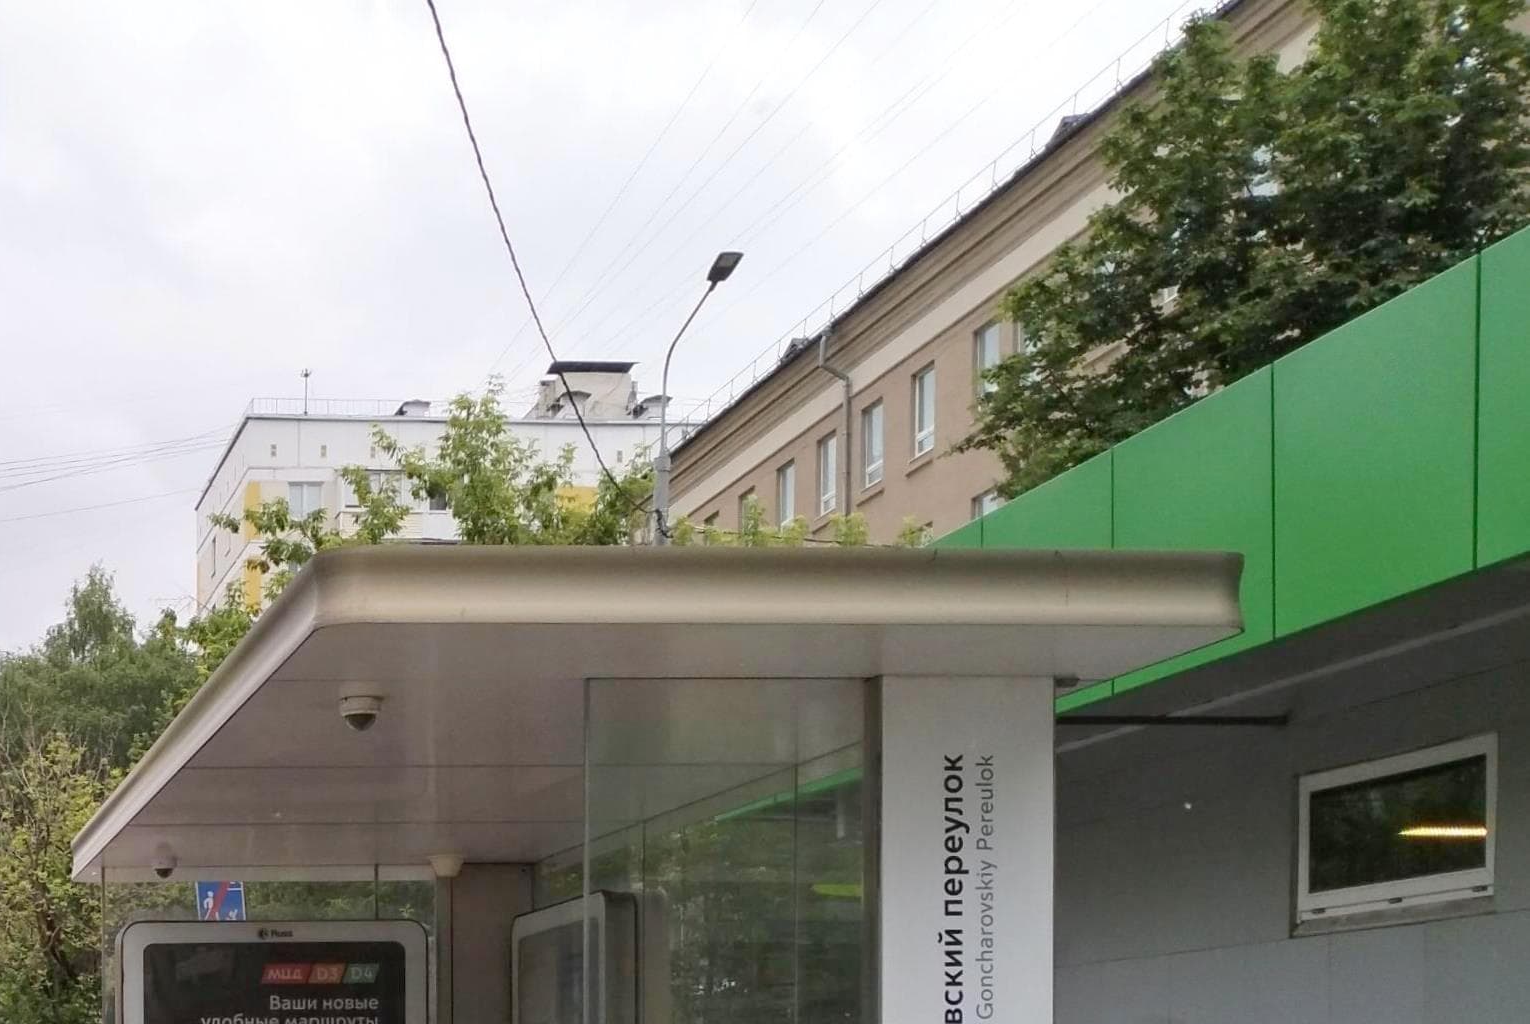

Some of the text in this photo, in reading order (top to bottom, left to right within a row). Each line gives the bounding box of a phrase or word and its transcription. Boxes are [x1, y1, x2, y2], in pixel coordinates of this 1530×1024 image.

[943, 754, 971, 917] переулок
[974, 754, 995, 851] Pereulok
[317, 968, 338, 980] D3
[351, 967, 373, 979] D4
[974, 859, 998, 1020] Goncharovskiy
[269, 995, 379, 1010] Ваши новые
